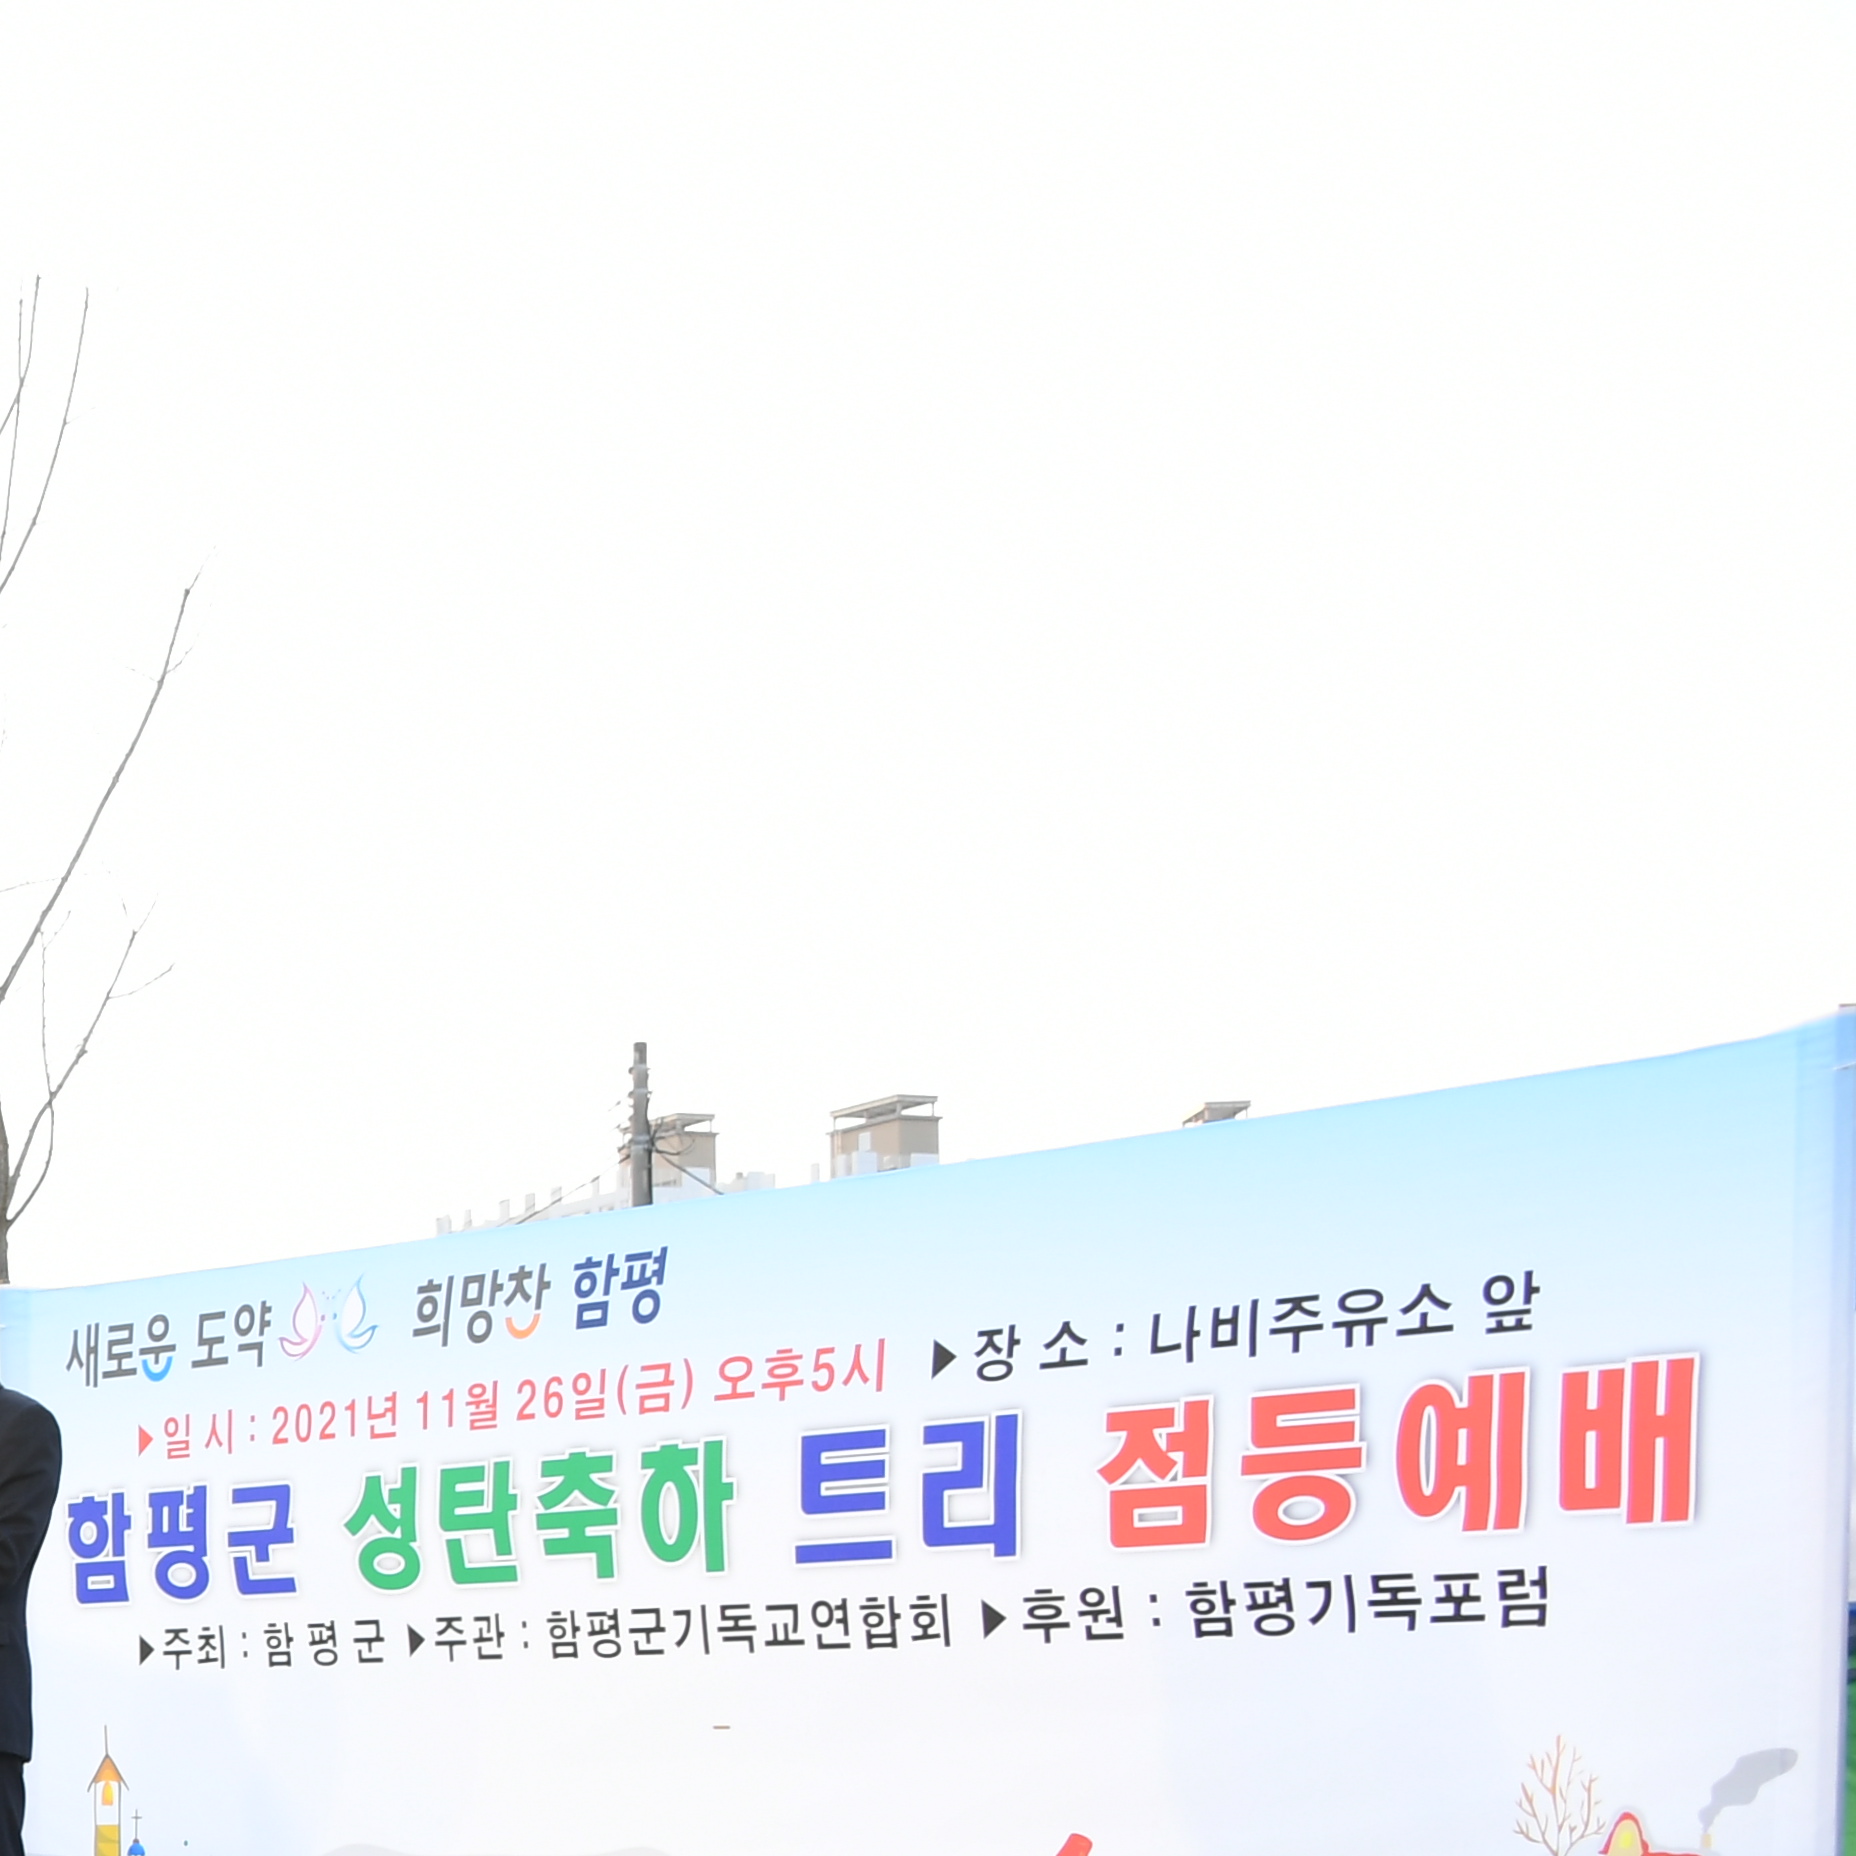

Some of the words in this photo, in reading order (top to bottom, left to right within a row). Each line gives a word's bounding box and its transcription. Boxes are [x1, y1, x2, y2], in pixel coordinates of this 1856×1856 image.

[573, 1246, 668, 1330] 함평
[1149, 1283, 1456, 1365] 나비주유소
[1481, 1269, 1542, 1334] 앞
[66, 1313, 177, 1388] 새로운
[191, 1300, 273, 1370] 도약
[272, 1390, 399, 1446] 2021년
[416, 1379, 499, 1431] 11월
[516, 1356, 694, 1422] 26일(금)
[713, 1337, 888, 1402] 오후5시
[67, 1482, 298, 1605] 함평군
[344, 1437, 735, 1592] 성탄축하
[795, 1413, 1020, 1562] 트리
[1096, 1353, 1699, 1551] 점등예배
[547, 1593, 952, 1660] 함평군기독교연합회
[1185, 1564, 1551, 1639] 함평기독포럼
